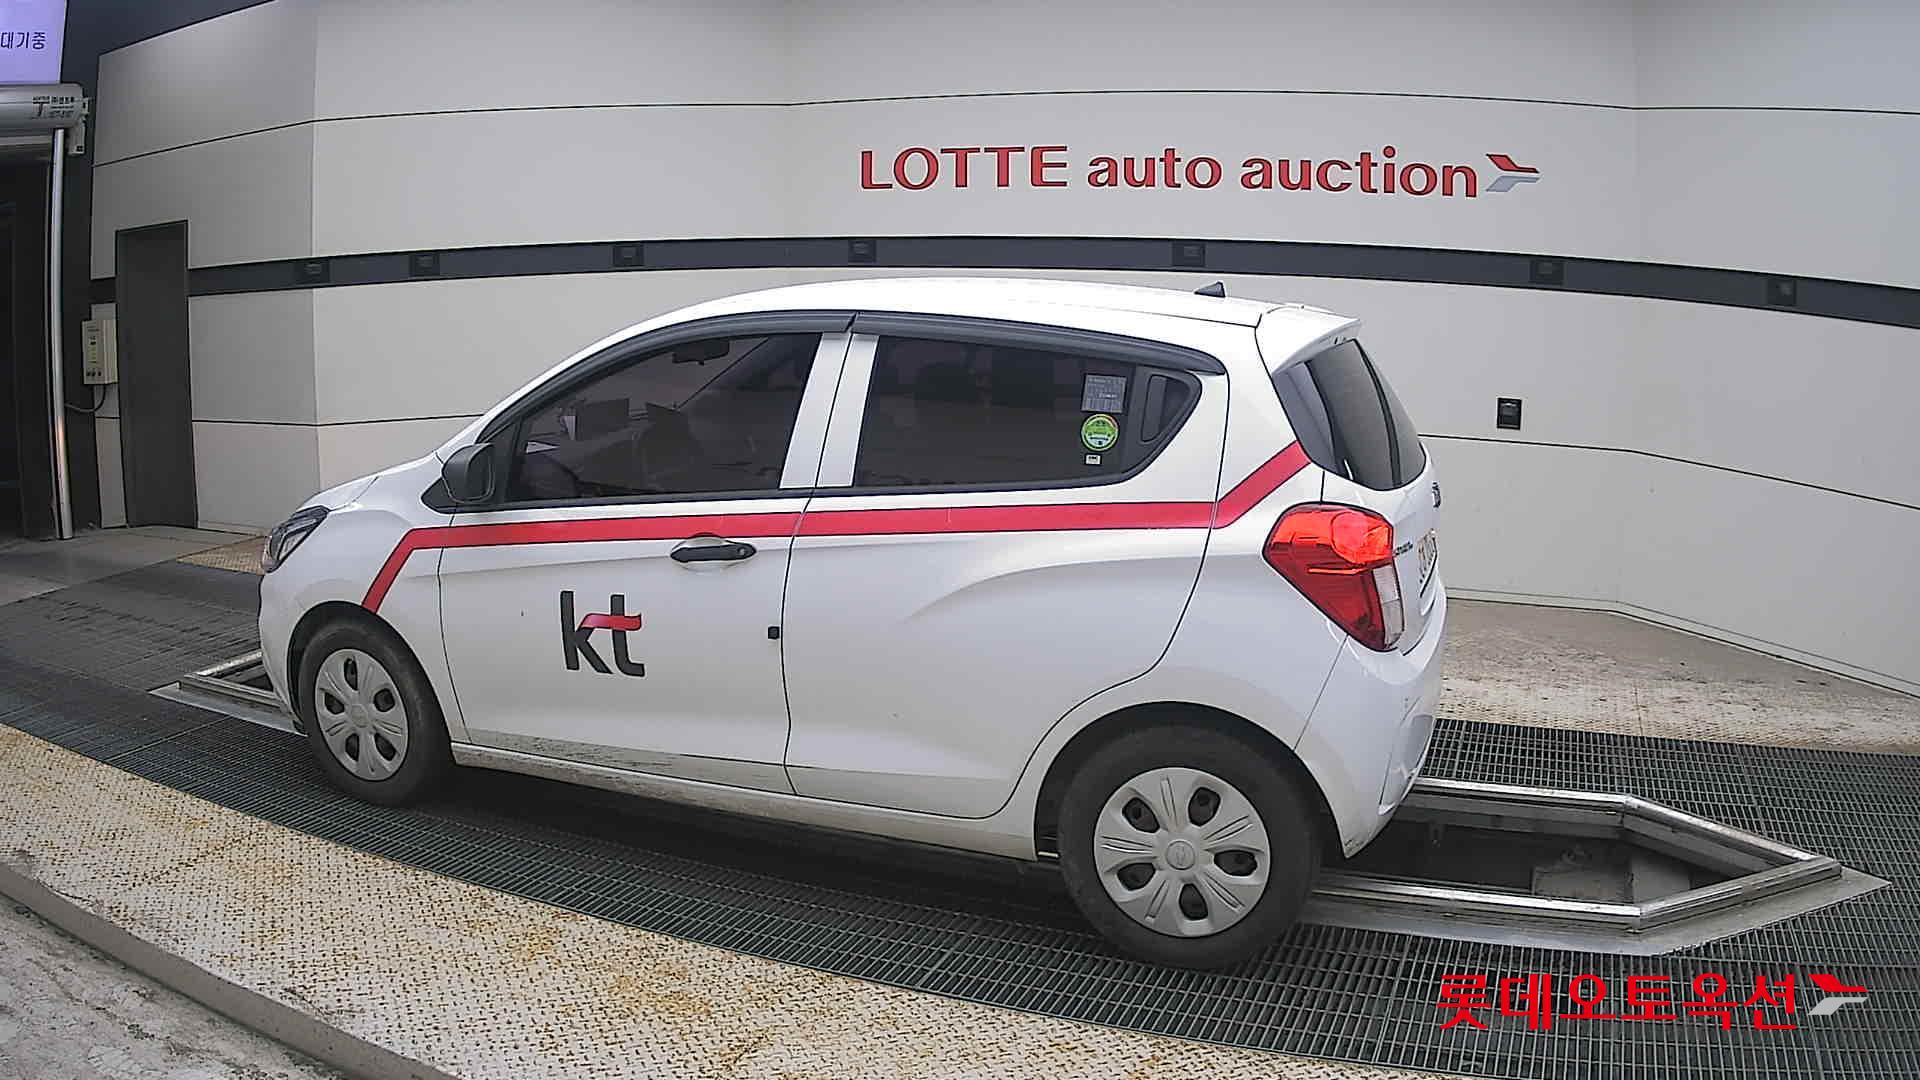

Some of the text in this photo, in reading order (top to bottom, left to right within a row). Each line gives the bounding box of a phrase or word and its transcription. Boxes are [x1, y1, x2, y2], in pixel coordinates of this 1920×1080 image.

[0, 31, 46, 50] 대기중
[861, 145, 1478, 198] LOTTE auto auction
[560, 590, 645, 677] kt
